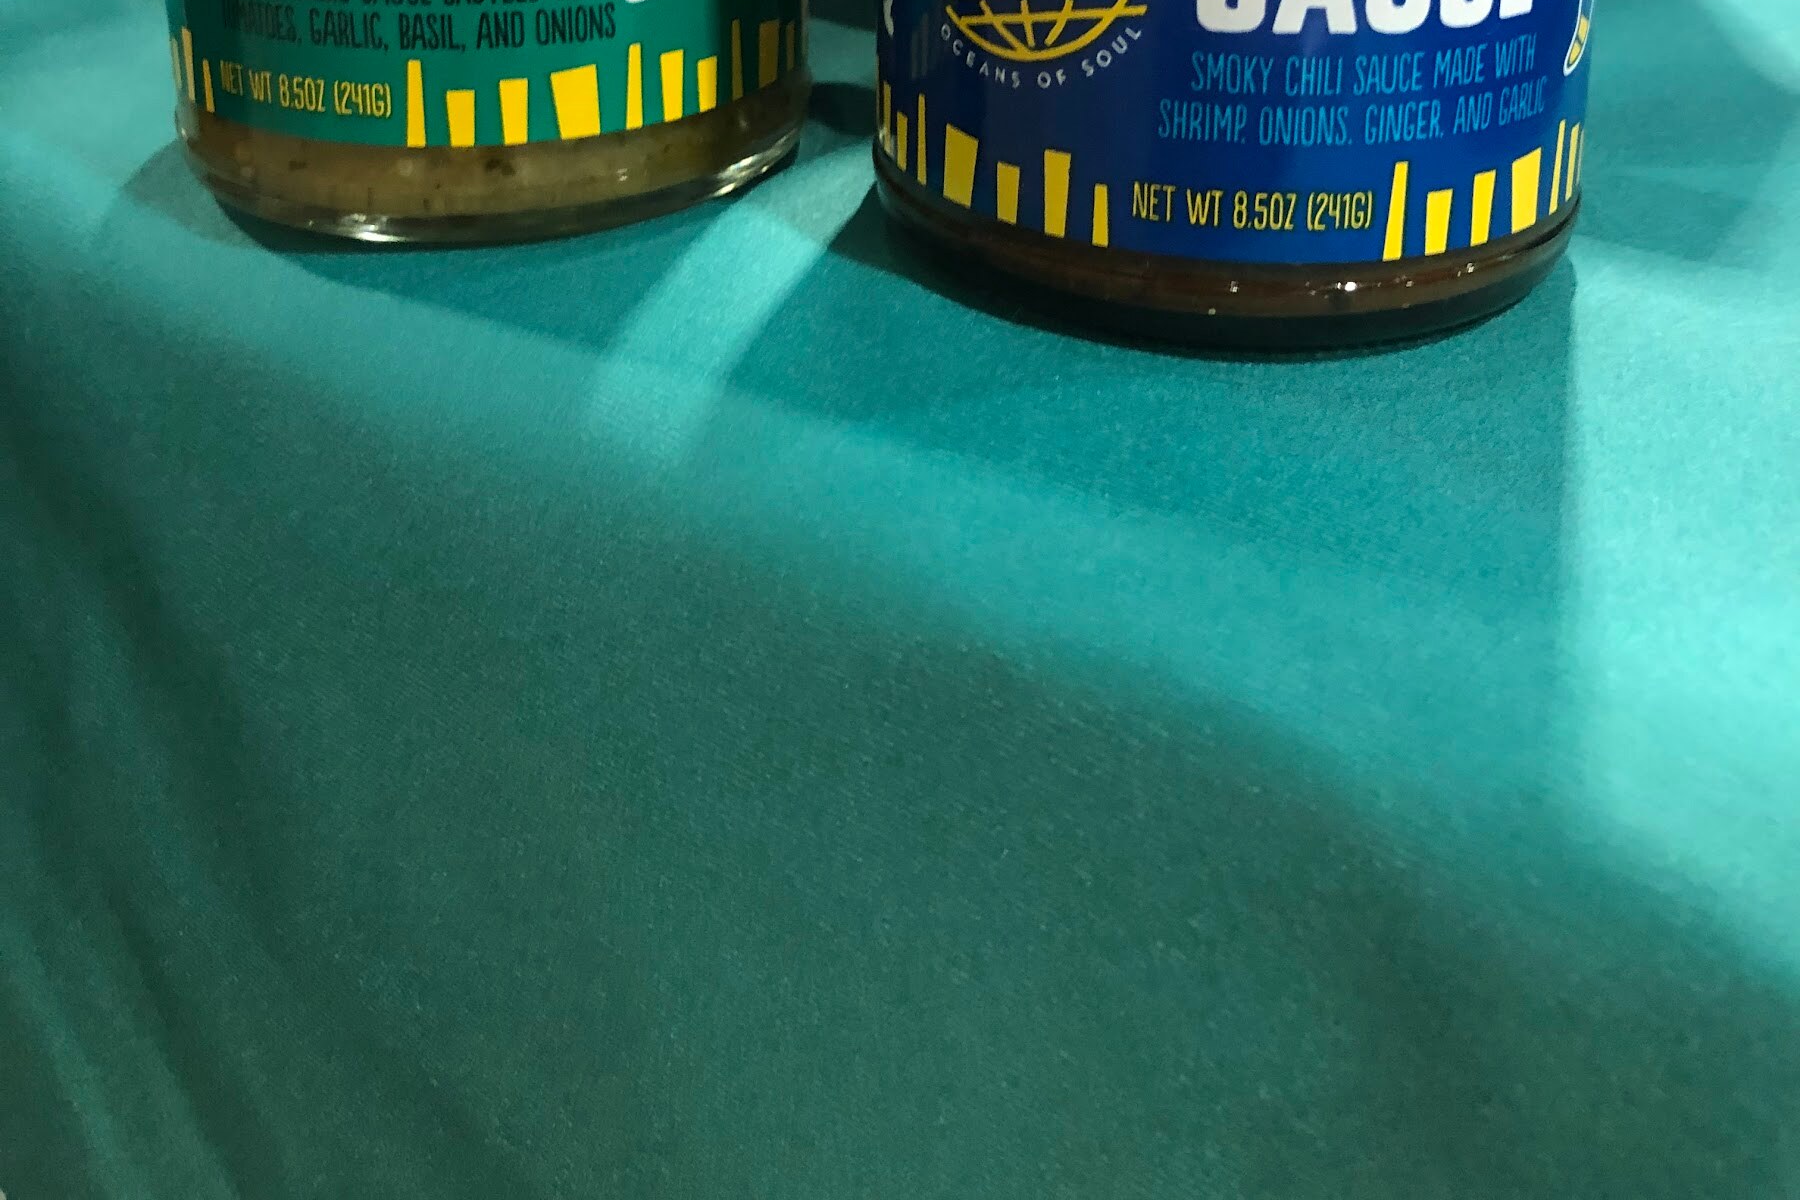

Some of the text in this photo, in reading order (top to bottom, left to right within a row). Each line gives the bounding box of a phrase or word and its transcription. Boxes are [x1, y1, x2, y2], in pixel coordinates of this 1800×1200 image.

[309, 6, 389, 56] GARLIC,
[398, 11, 467, 53] BASIL,
[476, 9, 525, 50] AND
[535, 1, 616, 47] ONIONS
[940, 22, 1143, 90] OCEANS OF SOUL
[219, 59, 244, 97] NET
[248, 69, 272, 105] WT
[333, 79, 392, 119] (241G)
[1190, 31, 1537, 97] SMOKY CHILI SAUCE MADE WITH
[1452, 91, 1493, 135] AND
[1498, 74, 1547, 126] GARLIC
[1131, 180, 1176, 223] NET
[1185, 187, 1224, 227] WT
[1305, 189, 1373, 232] (241G)
